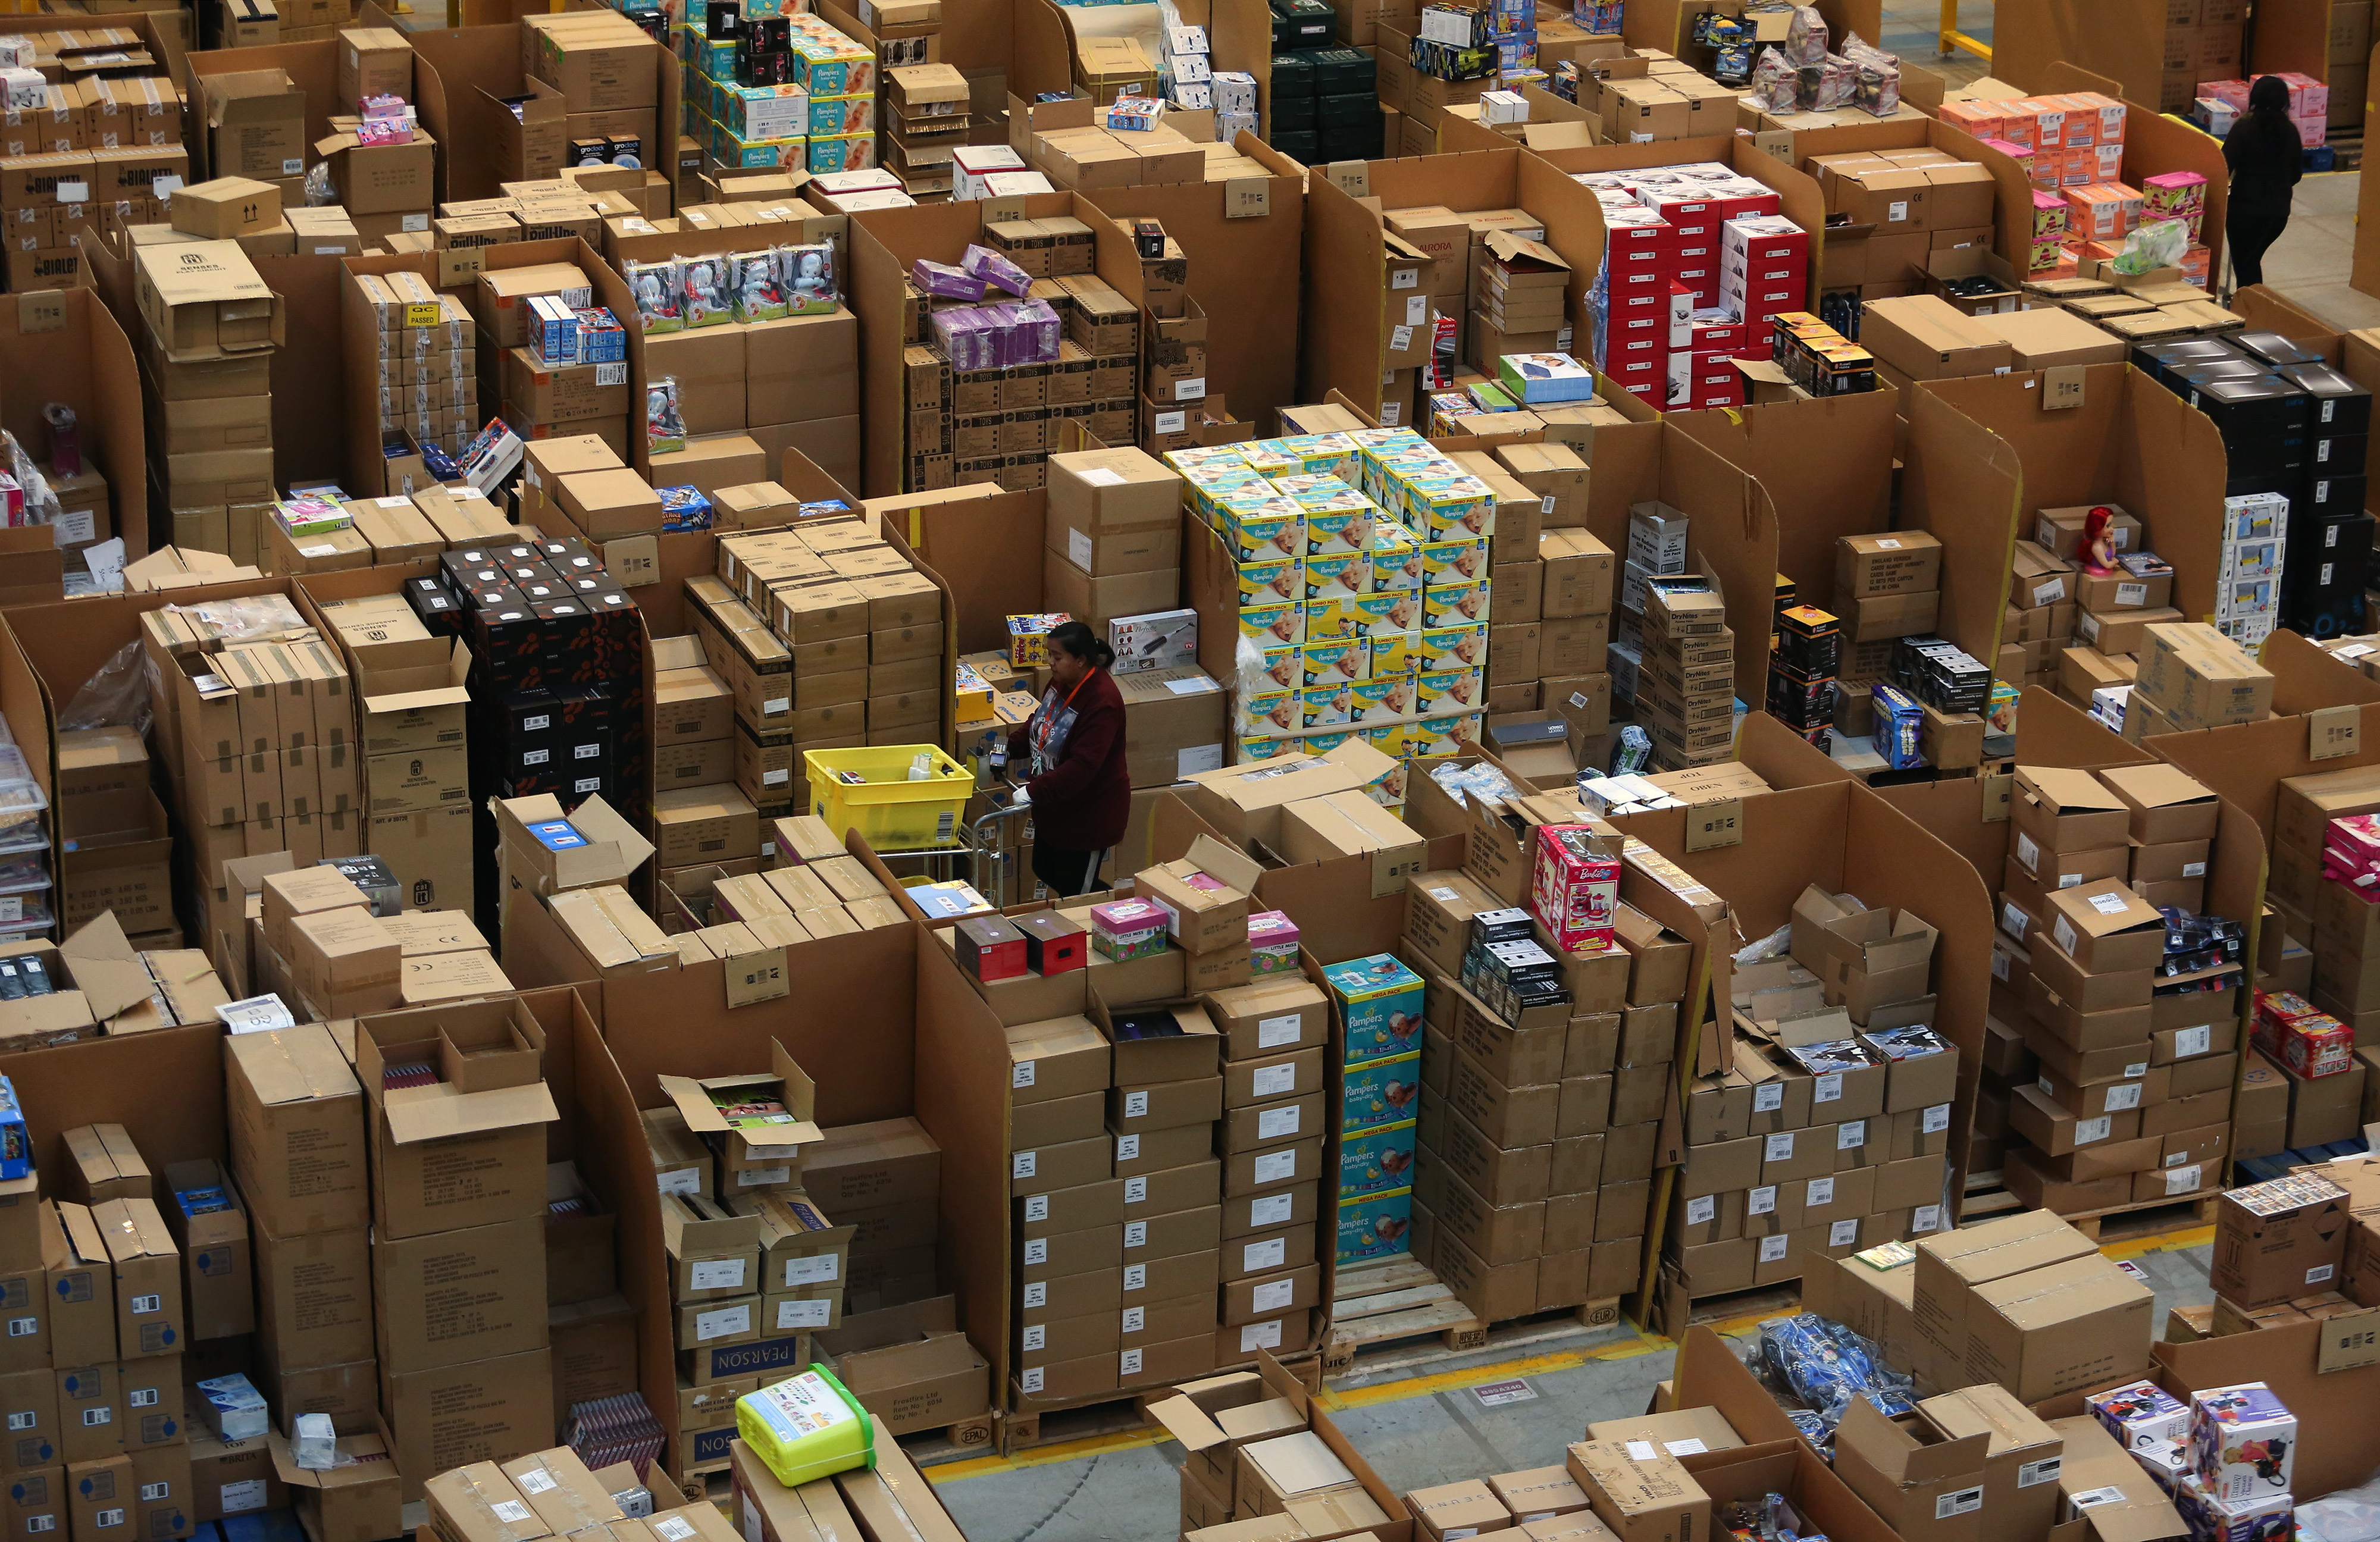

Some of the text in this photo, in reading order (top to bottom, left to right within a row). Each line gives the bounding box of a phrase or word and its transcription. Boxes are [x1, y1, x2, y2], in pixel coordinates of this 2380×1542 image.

[581, 145, 605, 154] groclock
[615, 142, 638, 152] groclock
[1255, 528, 1275, 537] Pampers
[643, 557, 650, 568] A1
[1253, 572, 1273, 581] Pampers
[1439, 595, 1460, 603] Pampers
[1688, 698, 1712, 707] DryNites
[1688, 726, 1712, 734] DryNites
[2345, 727, 2353, 738] A1
[1689, 757, 1712, 765] DryNites
[1727, 817, 1734, 828] A1
[1411, 862, 1420, 872] A1
[1580, 869, 1602, 879] Barbie
[770, 967, 779, 979] A1
[1349, 1013, 1383, 1030] Pampers
[1352, 1023, 1378, 1034] baby-dry
[1345, 1082, 1379, 1098] Pampers
[1349, 1092, 1374, 1103] baby-dry
[1341, 1150, 1374, 1167] Pampers
[1344, 1159, 1370, 1171] baby-dry
[1595, 1310, 1610, 1321] EUR
[2365, 1331, 2375, 1344] A1
[718, 1344, 790, 1370] PEARSON
[894, 1395, 923, 1406] Frostfire
[893, 1405, 908, 1414] Item
[893, 1412, 906, 1421] Qty
[965, 1430, 985, 1440] EPAL
[229, 1452, 256, 1463] BRITA
[1639, 1485, 1655, 1500] vtech
